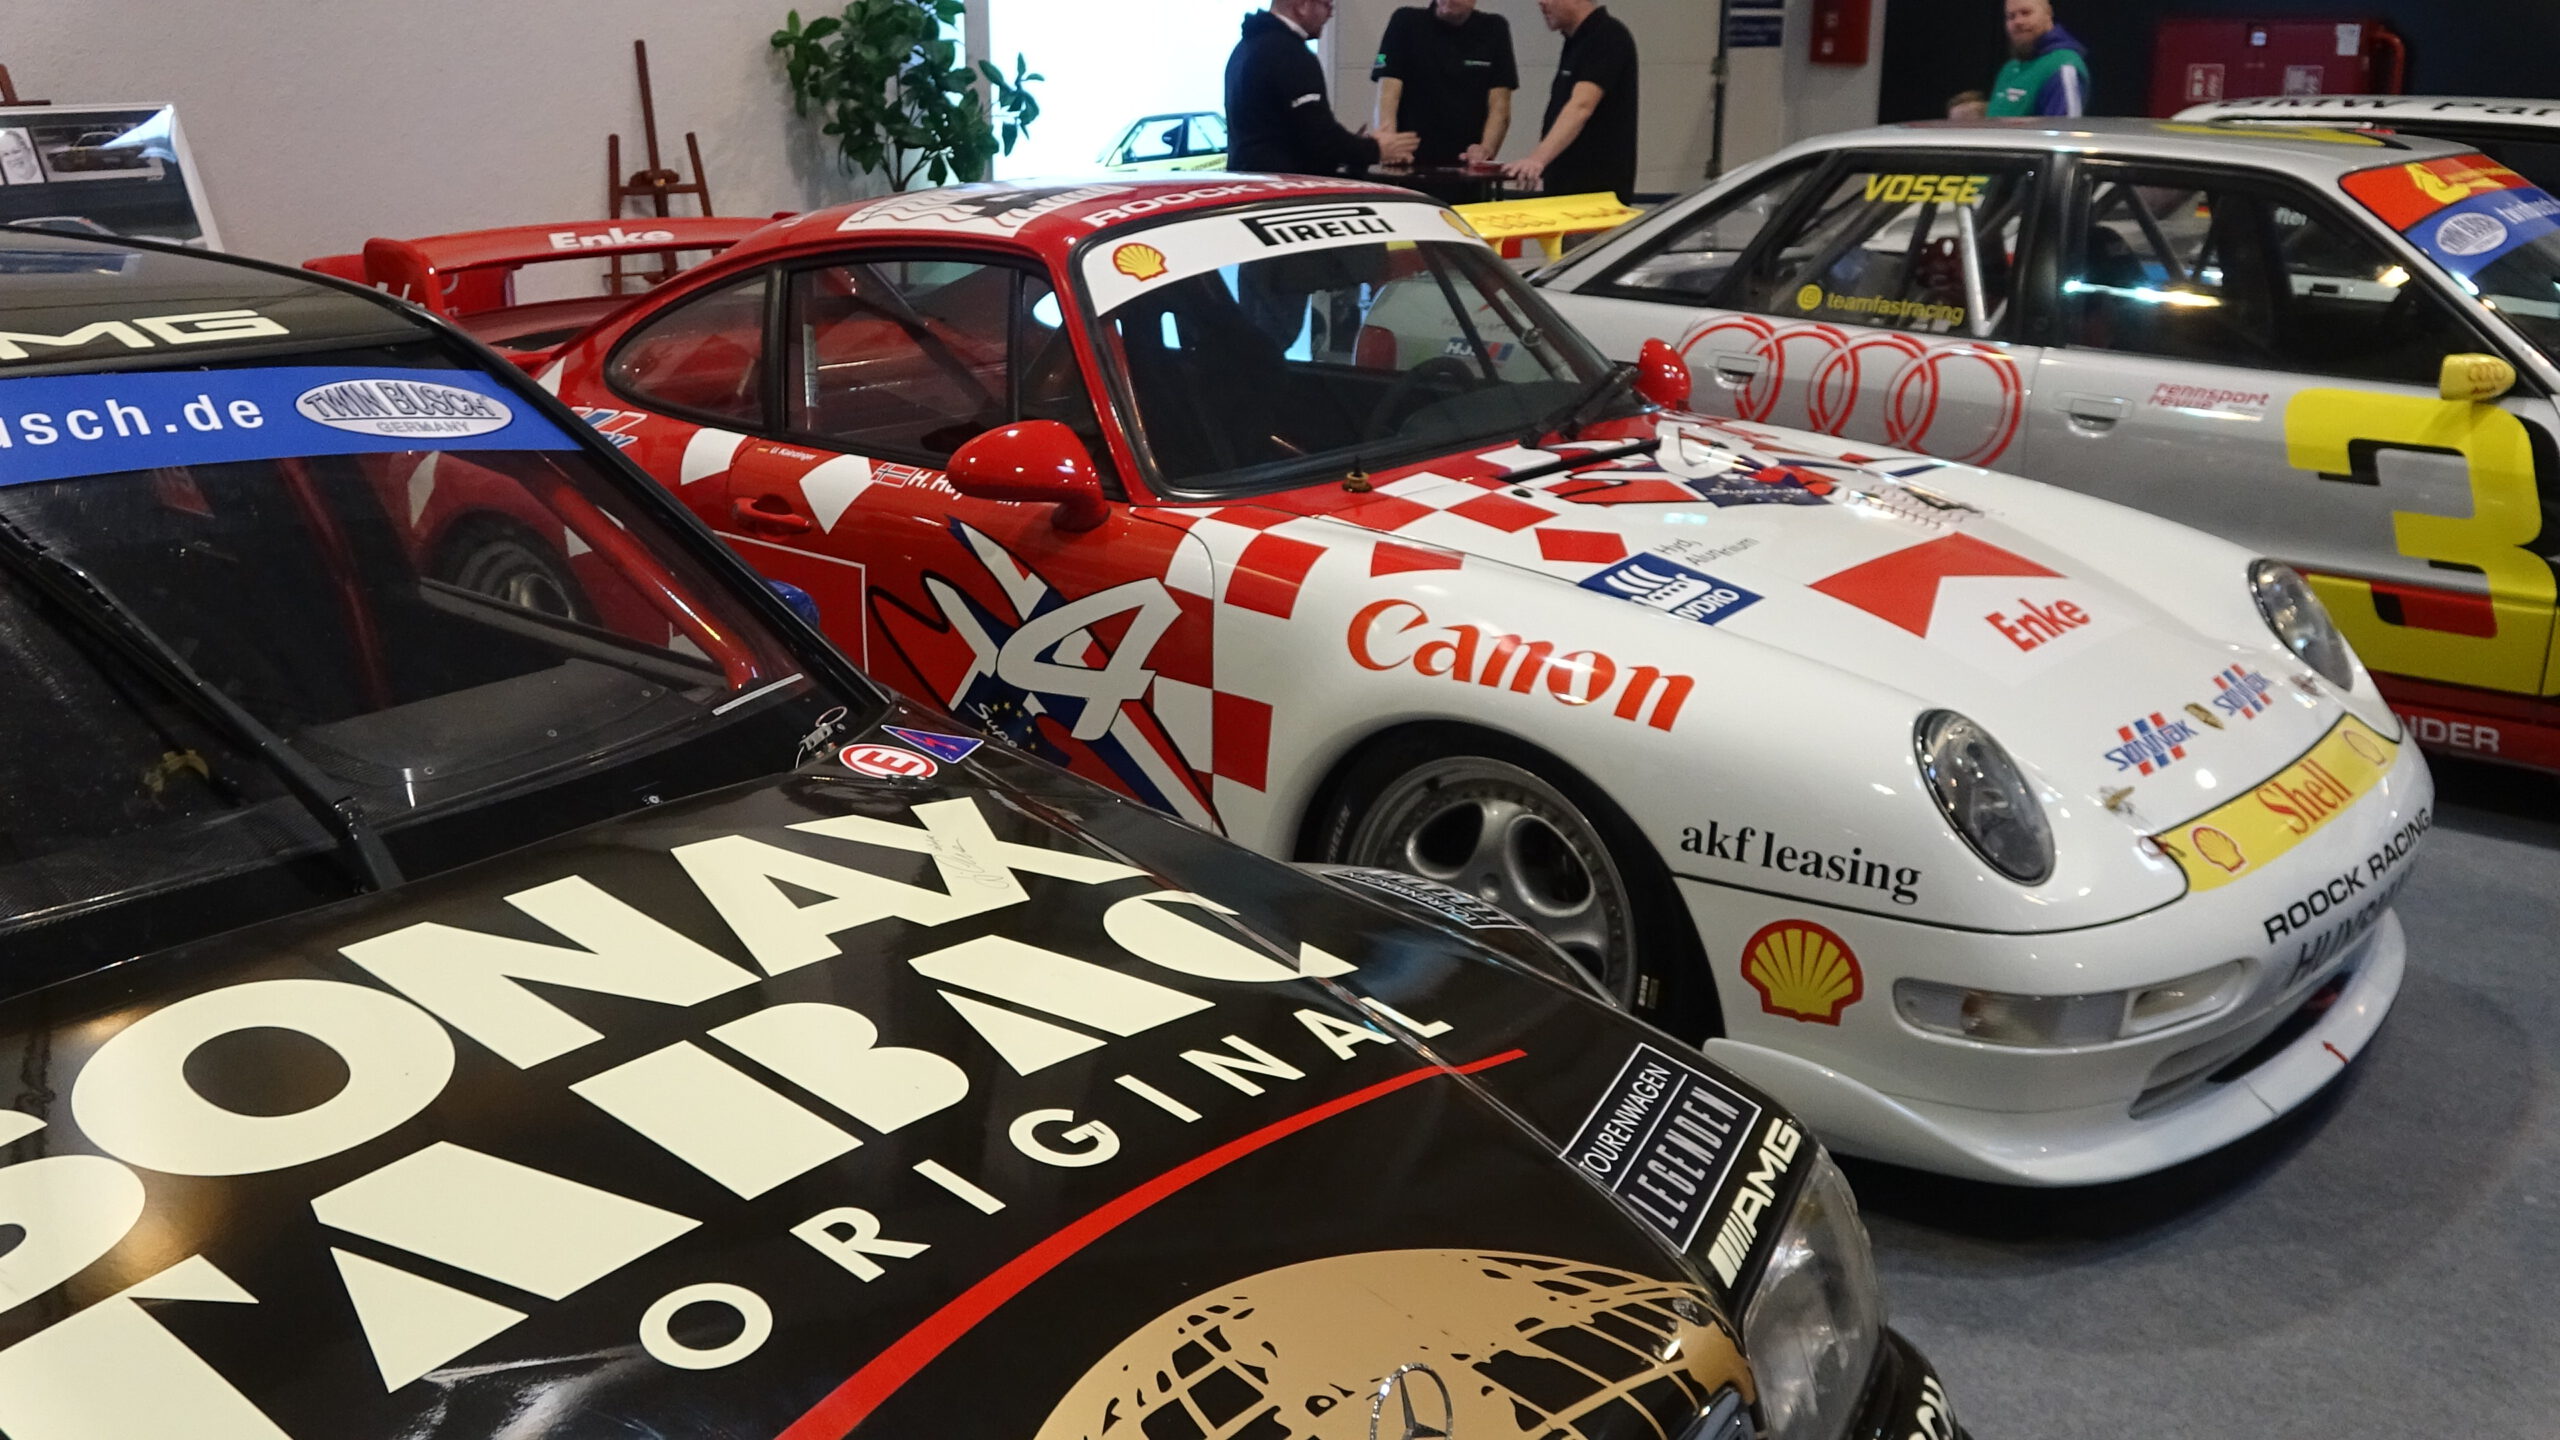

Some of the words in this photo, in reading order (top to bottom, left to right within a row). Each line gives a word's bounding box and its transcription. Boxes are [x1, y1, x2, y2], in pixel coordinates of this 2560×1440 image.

[1081, 183, 1264, 228] ROOCK
[1863, 174, 1990, 205] VOSSE
[548, 227, 675, 250] Enke
[1239, 206, 1397, 247] PIRELLI
[1826, 293, 1966, 327] teamfastracing
[303, 382, 392, 418] TWIN
[375, 381, 496, 417] BUSCH
[376, 420, 471, 434] GERMANY
[2155, 383, 2270, 405] rennsport
[2285, 388, 2560, 697] 3
[1985, 597, 2091, 653] Enke
[1346, 598, 1696, 732] Canon
[2255, 758, 2355, 835] Shell
[1680, 819, 1756, 861] akf
[1761, 830, 1923, 906] leasing
[2263, 866, 2367, 945] ROOCK
[2366, 807, 2432, 881] RACING
[1579, 1061, 1672, 1180] TOURENWAGEN
[638, 997, 1454, 1371] ORIGINAL
[1627, 1085, 1741, 1231] LEGENDEN
[1728, 1117, 1802, 1242] AMG
